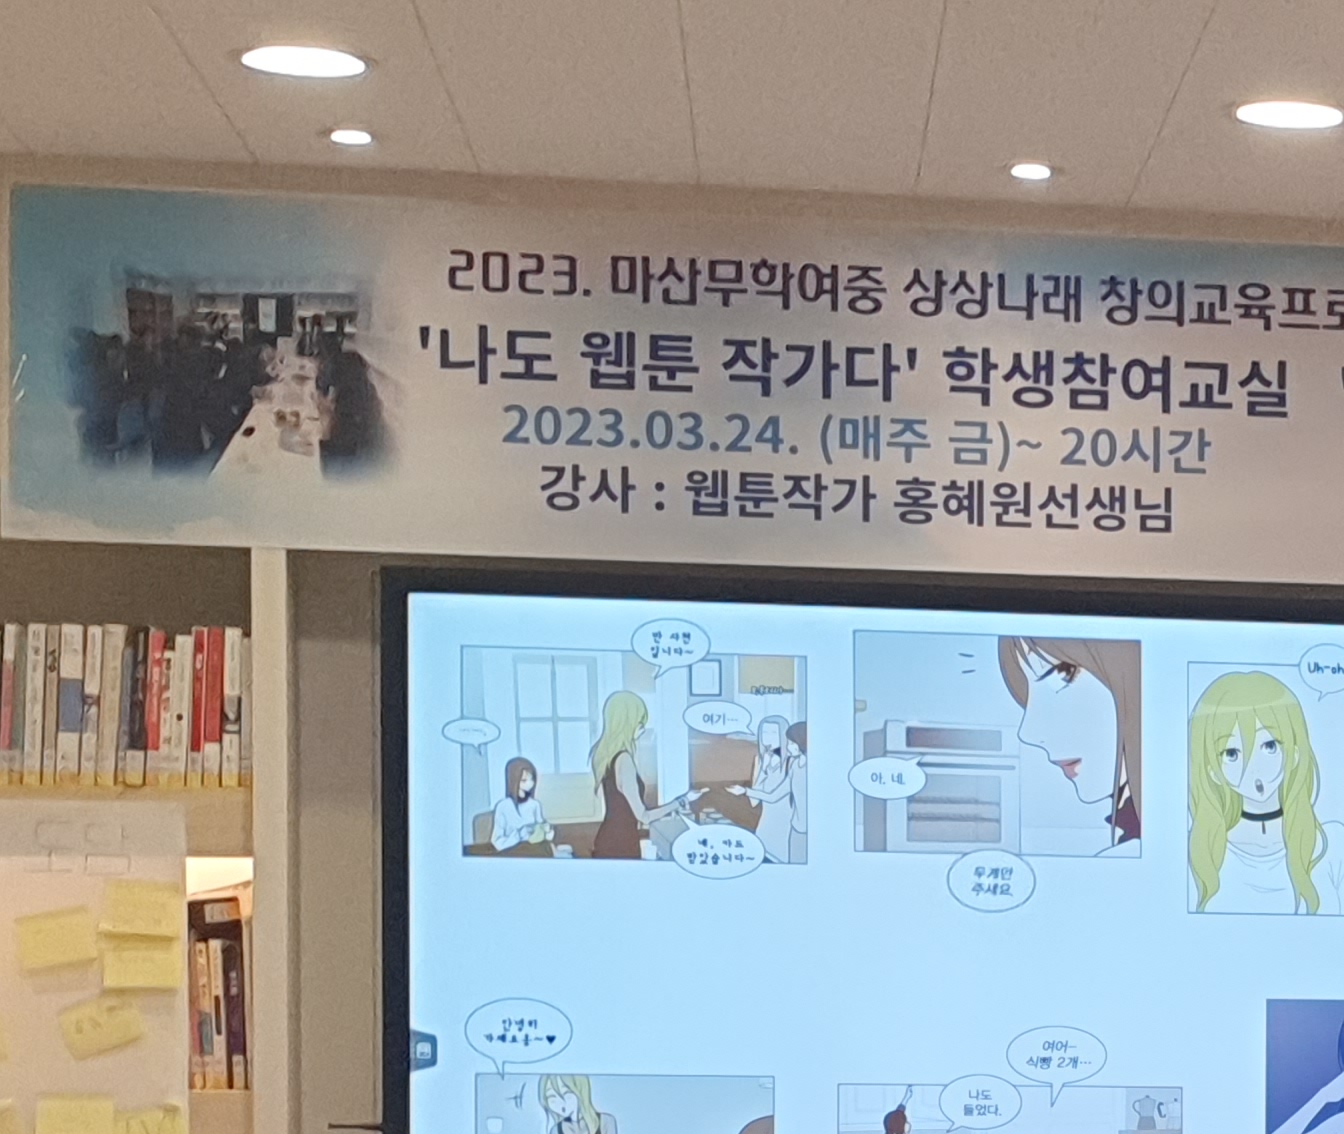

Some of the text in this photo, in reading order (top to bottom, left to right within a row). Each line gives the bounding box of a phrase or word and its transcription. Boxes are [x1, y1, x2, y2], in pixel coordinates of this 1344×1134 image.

[448, 249, 592, 297] 2023.
[610, 254, 888, 315] 마산무학여중
[902, 266, 1083, 324] 상상나래
[419, 324, 1290, 419] '나도 웹툰 작가다' 학생참여교실
[500, 403, 1213, 475] 2023.03.24. (매주 금)~ 20시간
[539, 464, 637, 514] 강사
[684, 469, 878, 523] 웹툰작가
[893, 475, 1175, 534] 홍혜원선생님
[968, 1088, 993, 1101] 나도
[1026, 1055, 1053, 1070] 식빵
[963, 1103, 1003, 1117] 들었다.
